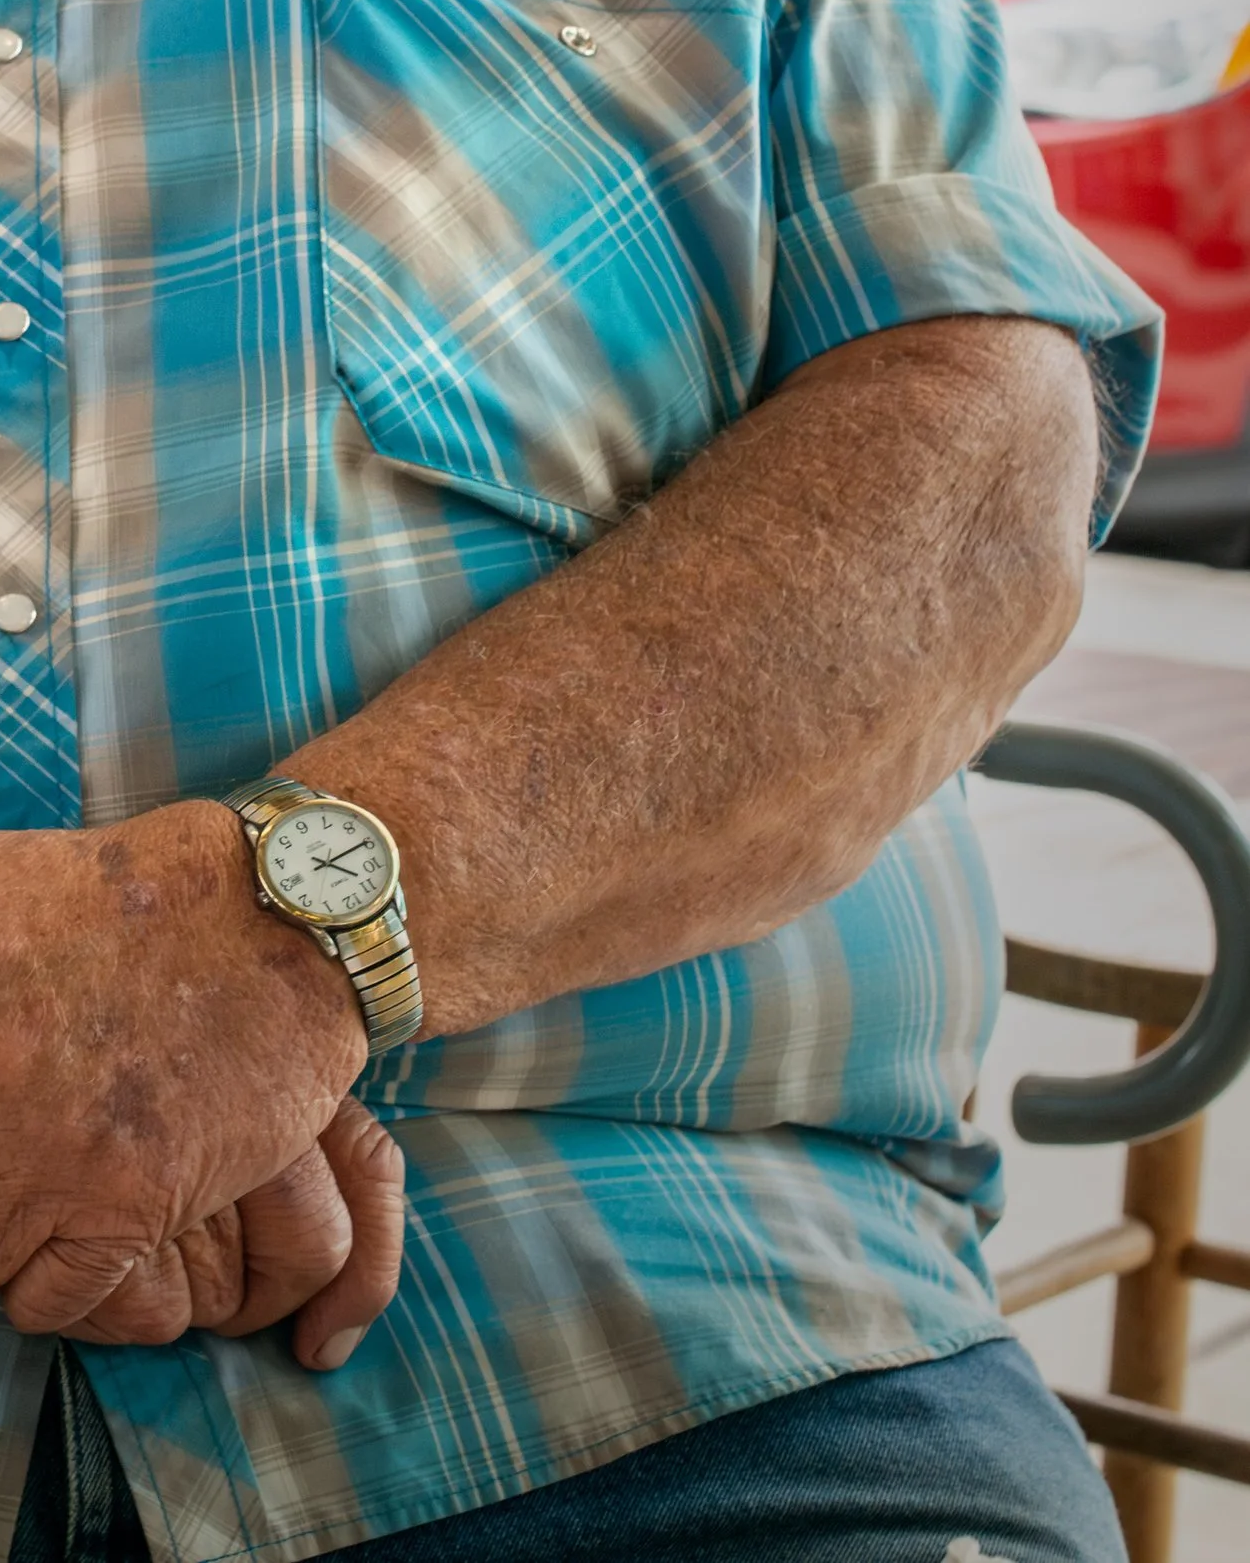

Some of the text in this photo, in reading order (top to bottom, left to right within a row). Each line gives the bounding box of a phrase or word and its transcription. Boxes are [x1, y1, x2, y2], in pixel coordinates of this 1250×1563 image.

[296, 821, 308, 835] 6
[322, 816, 333, 830] 7
[343, 821, 356, 835] 8
[279, 836, 292, 849] 5
[363, 837, 375, 849] 9
[274, 857, 285, 869] 4
[363, 857, 382, 873] 10
[280, 878, 292, 891] 3
[359, 878, 377, 894] 11
[298, 894, 312, 907] 2
[323, 900, 333, 913] 1
[342, 893, 362, 909] 12
